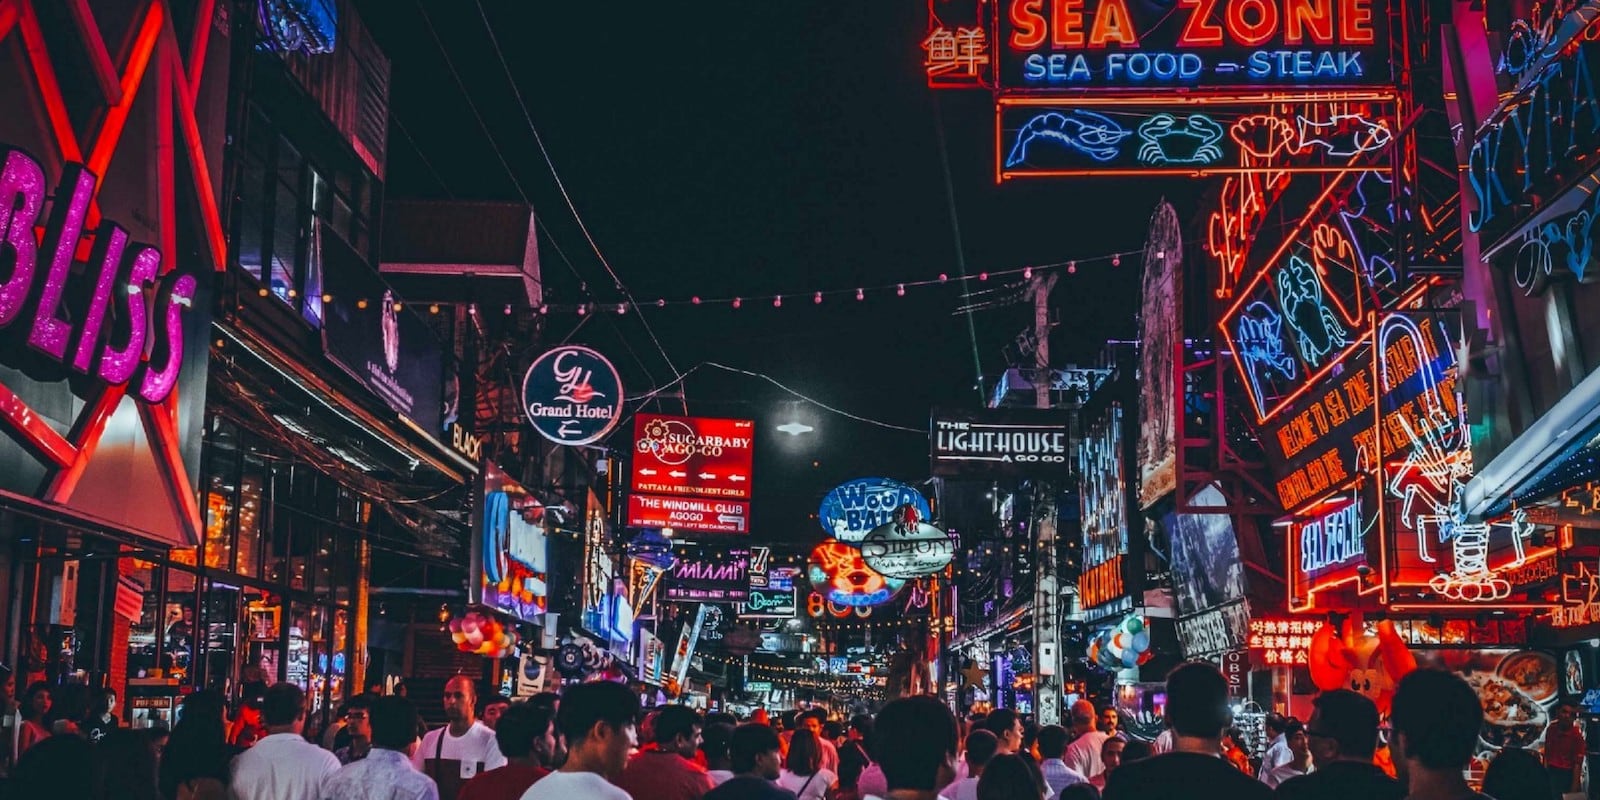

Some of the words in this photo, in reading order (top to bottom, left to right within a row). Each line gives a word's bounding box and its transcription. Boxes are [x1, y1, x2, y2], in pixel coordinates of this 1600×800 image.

[1009, 0, 1141, 50] SEA
[1177, 0, 1376, 48] ZONE
[1023, 53, 1092, 80] SEA
[1106, 52, 1204, 80] FOOD
[1247, 50, 1364, 78] STEAK
[0, 148, 198, 404] BLISS
[529, 402, 572, 418] Grand
[575, 403, 613, 419] Hotel
[1309, 400, 1329, 437] TO
[1323, 387, 1350, 428] SEA
[936, 421, 970, 431] THE
[669, 433, 751, 449] SUGARBABY
[937, 431, 1065, 453] LIGHTHOUSE
[665, 443, 723, 457] AGO-GO
[1001, 454, 1013, 463] A
[1014, 454, 1039, 463] GO
[1041, 454, 1065, 464] GO
[638, 483, 672, 492] PATTAYA
[673, 485, 721, 495] FRIENDLIEST
[722, 488, 745, 497] GIRLS
[639, 498, 661, 509] THE
[662, 499, 713, 513] WINDMILL
[714, 503, 743, 514] CLUB
[643, 519, 666, 527] METERS
[667, 520, 683, 528] TURN
[670, 511, 704, 521] AGOGO
[870, 534, 950, 557] SIMON
[1301, 520, 1326, 573] SEA
[1323, 502, 1364, 566] ZONE
